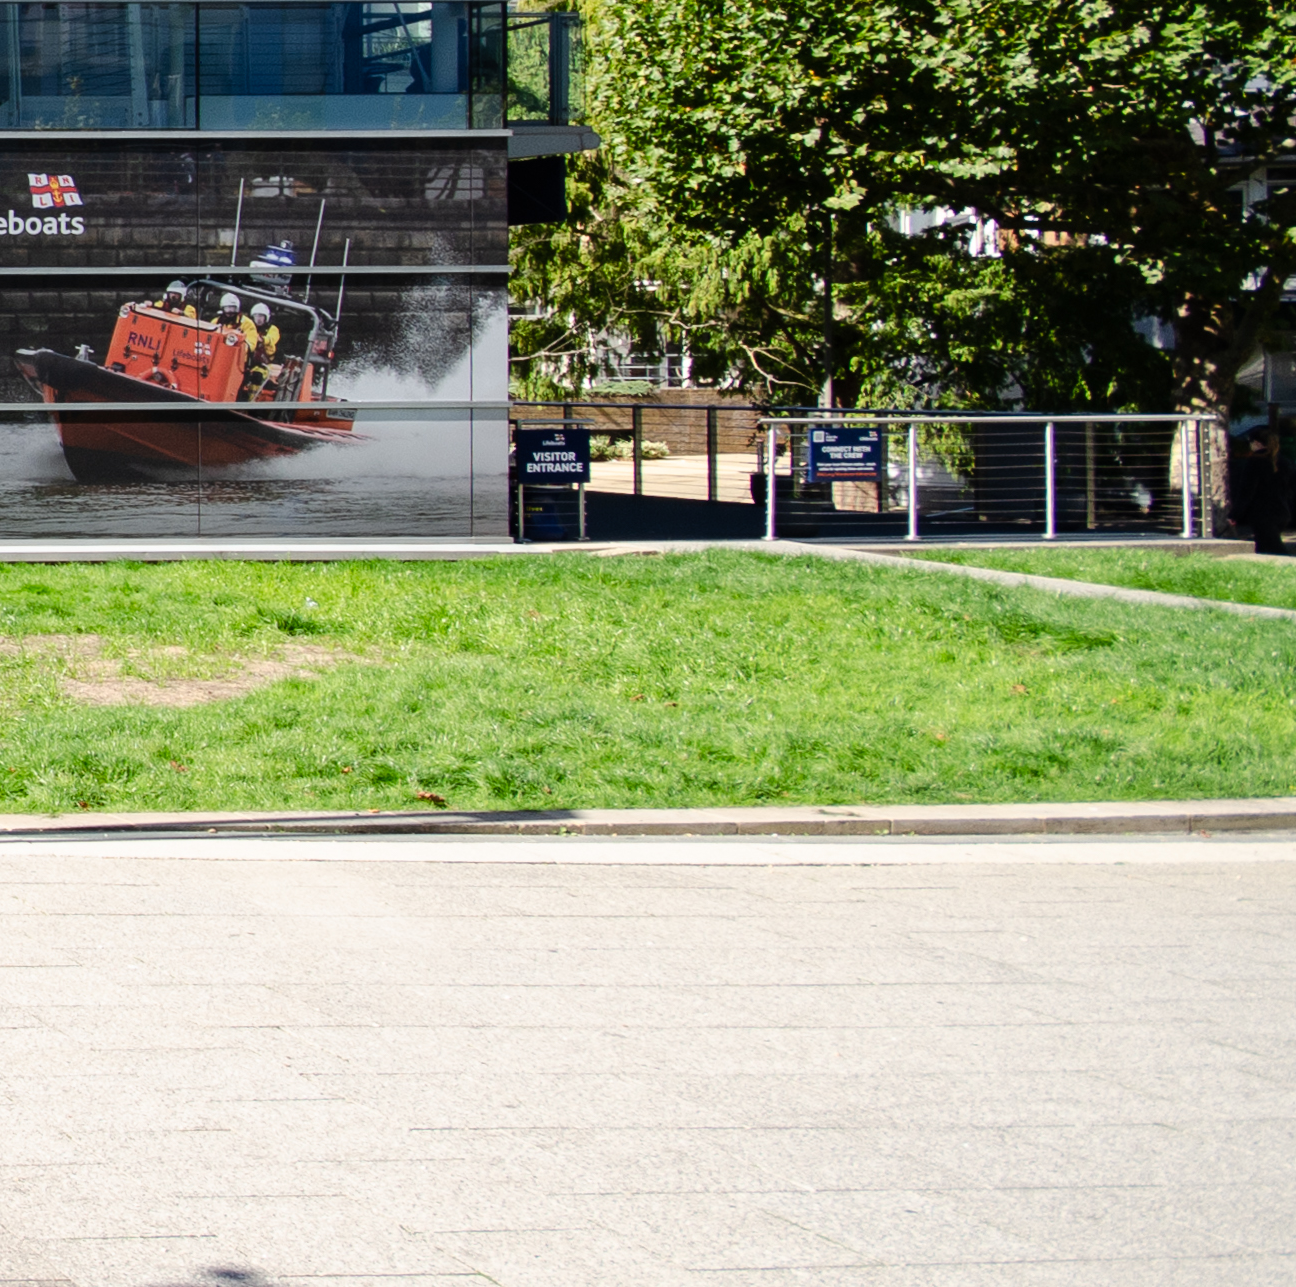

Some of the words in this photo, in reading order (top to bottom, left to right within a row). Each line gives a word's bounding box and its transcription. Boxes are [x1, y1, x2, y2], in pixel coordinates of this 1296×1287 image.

[127, 331, 161, 351] RNLI
[534, 452, 576, 461] VISITOR
[527, 463, 583, 472] ENTRANCE
